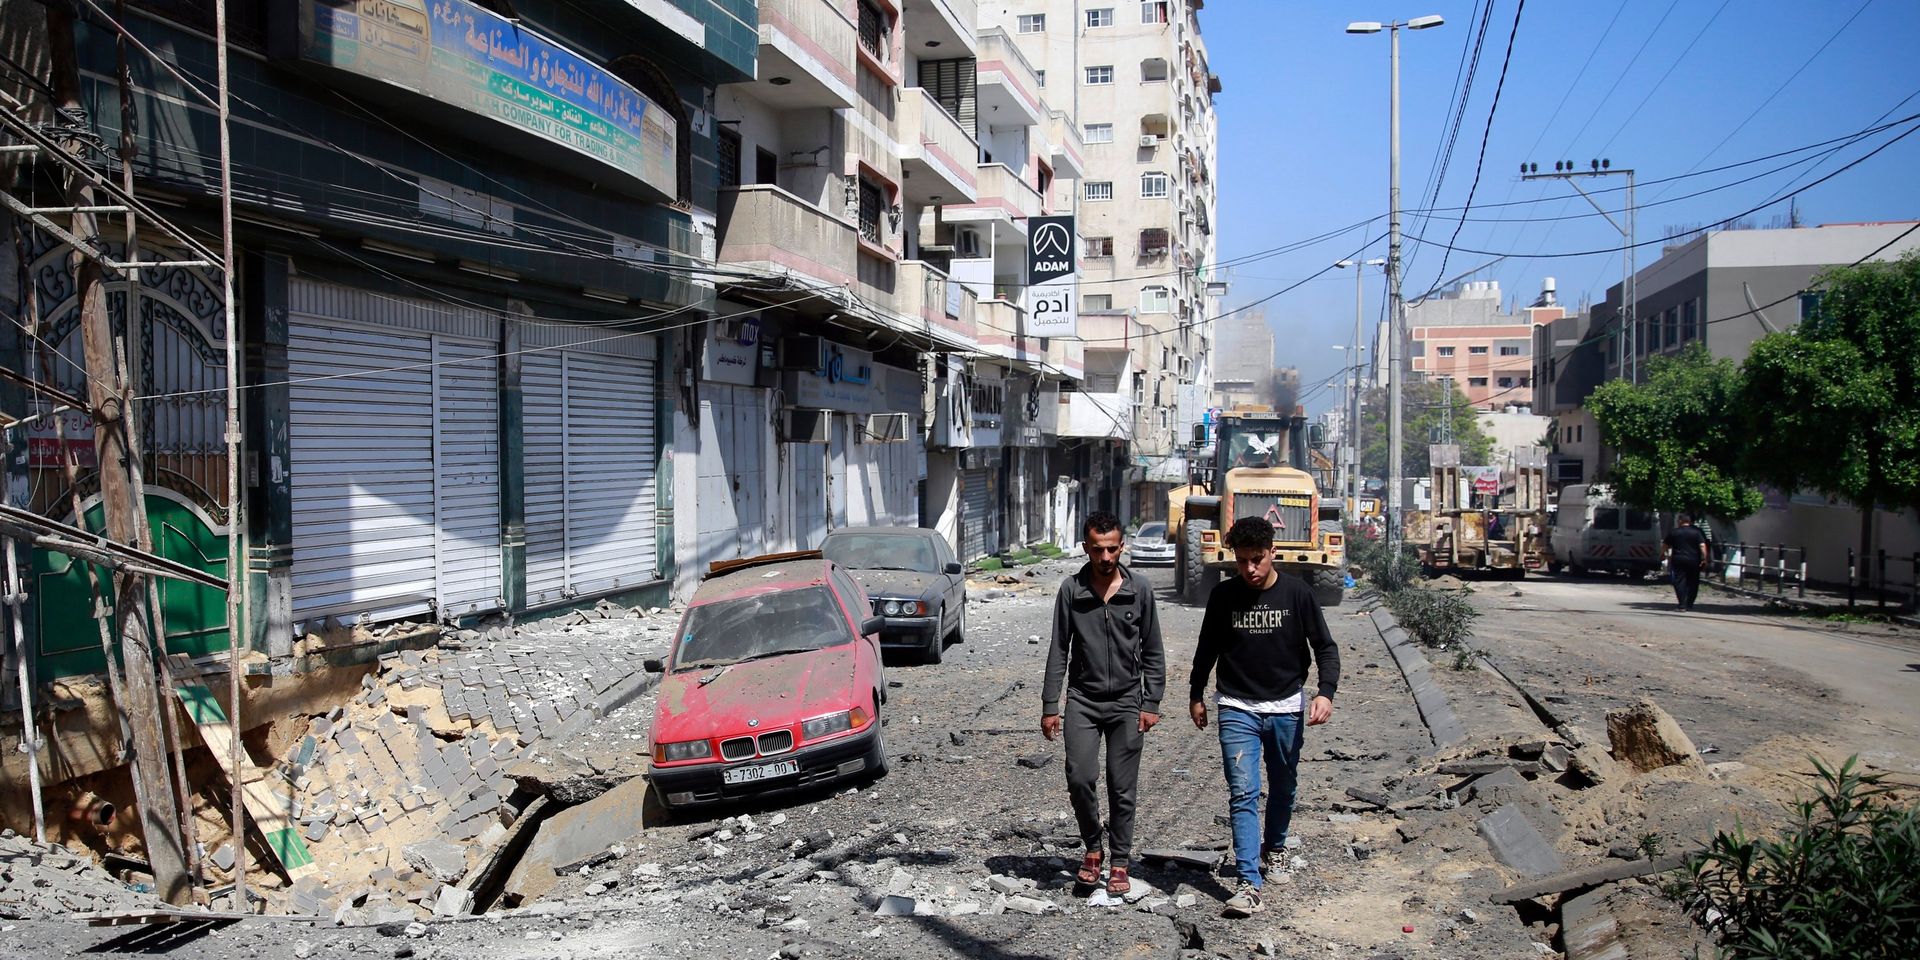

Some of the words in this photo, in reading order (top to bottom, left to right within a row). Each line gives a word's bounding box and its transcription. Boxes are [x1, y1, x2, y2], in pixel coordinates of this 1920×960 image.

[463, 14, 529, 71] الصناعة
[540, 50, 585, 96] للتجارة
[586, 72, 603, 106] الله
[604, 89, 618, 120] رام
[619, 87, 641, 129] شركة
[502, 103, 553, 135] COMPANY
[554, 124, 572, 143] FOR
[575, 133, 609, 159] TRADING
[1034, 261, 1069, 272] ADAM
[1033, 288, 1070, 319] آدم
[1034, 316, 1069, 327] للتجميل
[1360, 501, 1374, 511] CAT
[1232, 610, 1282, 628] BLEECKER
